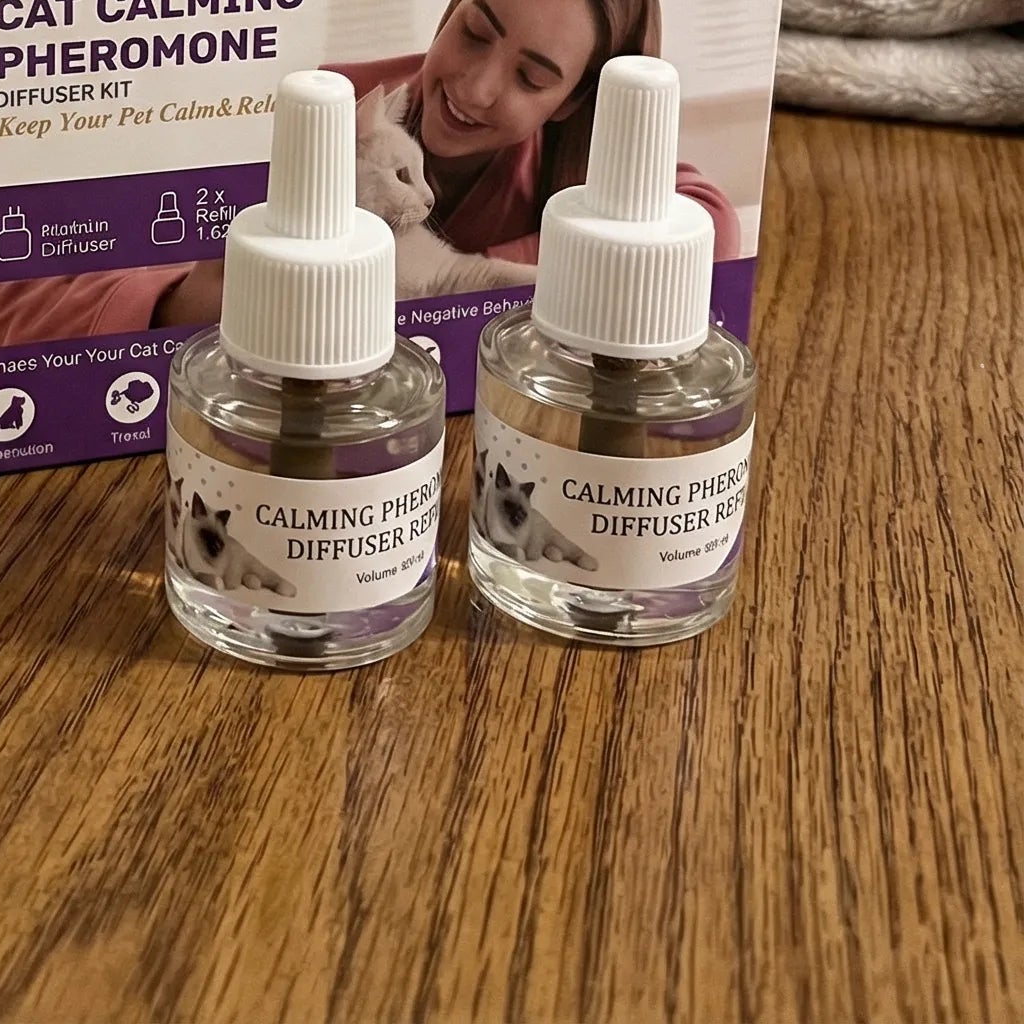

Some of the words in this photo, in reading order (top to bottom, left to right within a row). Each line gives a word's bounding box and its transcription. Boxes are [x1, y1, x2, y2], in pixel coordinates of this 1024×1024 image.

[100, 80, 133, 100] KIT
[60, 111, 113, 132] Your
[117, 105, 154, 127] Pet
[196, 187, 208, 206] 2
[411, 304, 479, 325] Negative
[42, 353, 82, 370] Your
[86, 347, 126, 364] Your
[129, 342, 159, 358] Cat
[562, 478, 681, 508] CALMING
[255, 503, 374, 531] CALMING
[591, 508, 710, 537] DIFFUSER
[286, 526, 405, 561] DIFFUSER
[659, 547, 701, 563] Volume
[356, 564, 398, 584] Volume
